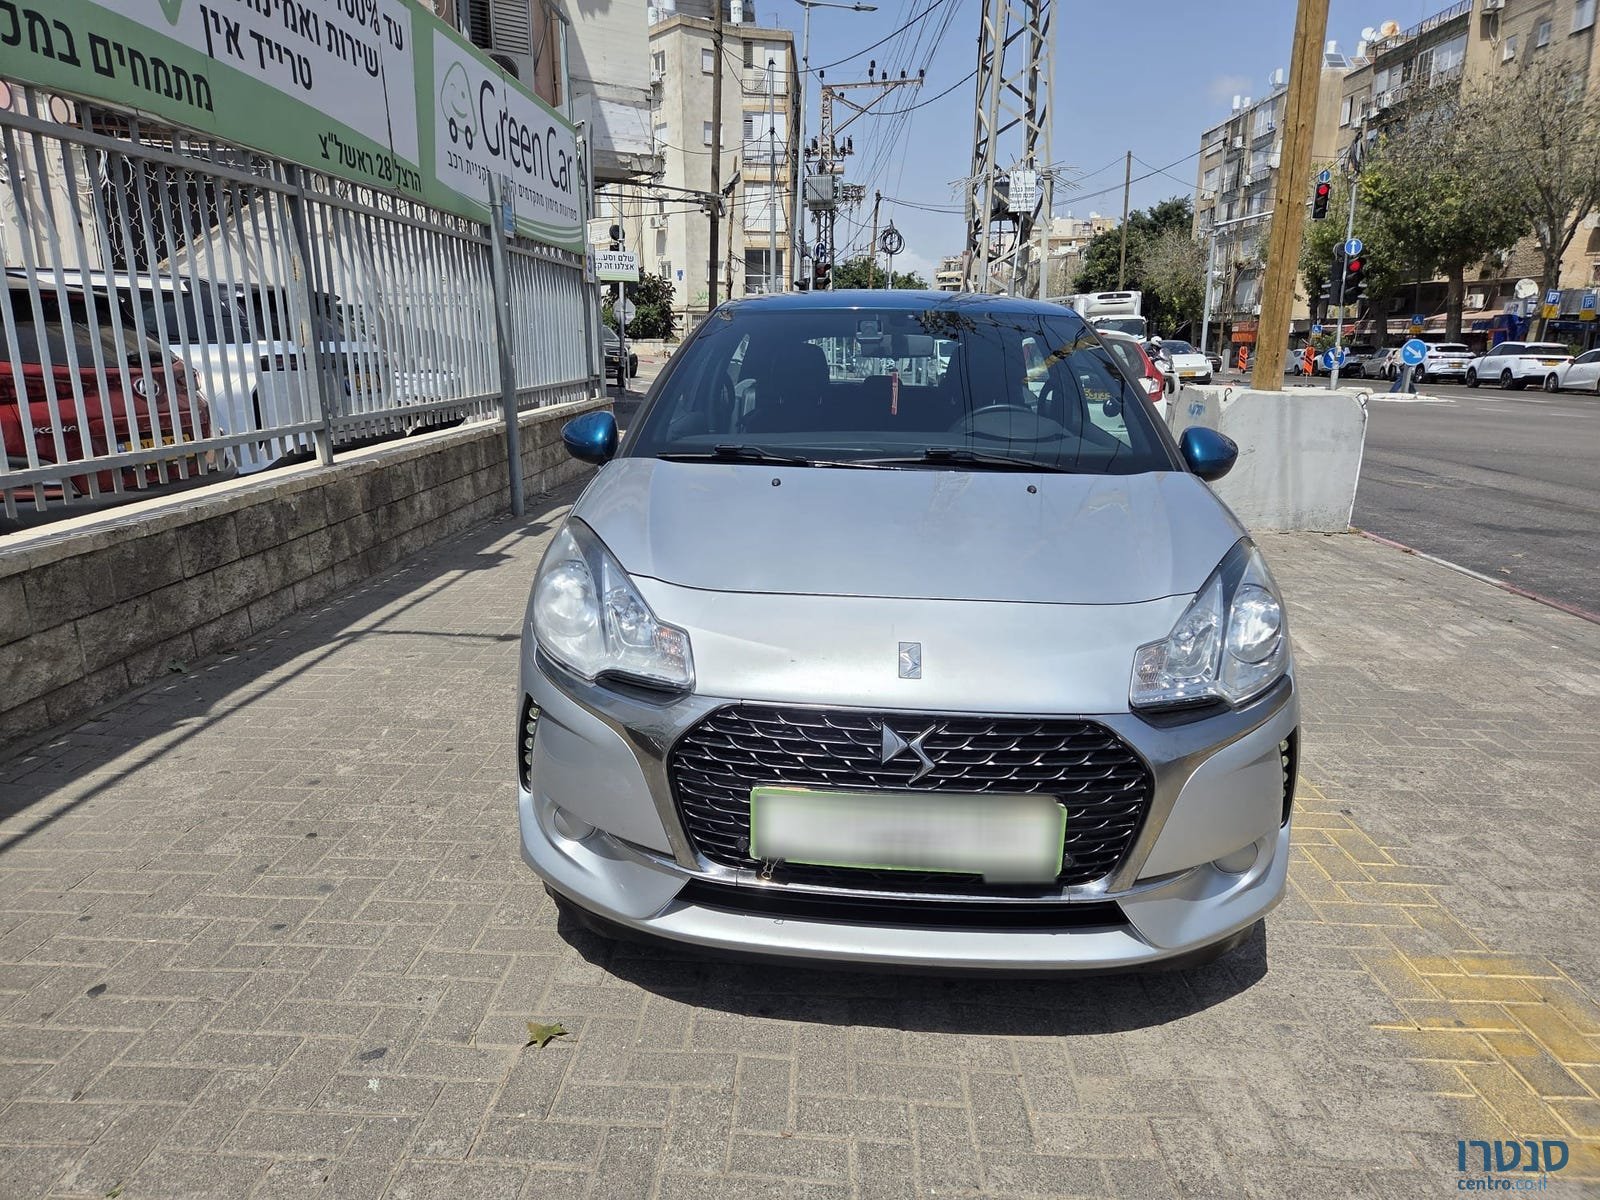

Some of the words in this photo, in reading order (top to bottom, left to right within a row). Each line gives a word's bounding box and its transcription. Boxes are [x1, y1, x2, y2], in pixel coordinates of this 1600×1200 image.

[200, 4, 245, 60] אין
[236, 0, 321, 46] ואמינ
[382, 13, 405, 51] עד
[249, 29, 312, 91] טרייד
[325, 20, 379, 77] שירות
[88, 32, 213, 112] מתמחים
[480, 80, 543, 180] Green
[547, 126, 572, 195] Car
[376, 153, 392, 181] 28
[394, 159, 421, 193] הרצל
[447, 150, 463, 172] רכב
[618, 254, 634, 262] שלם
